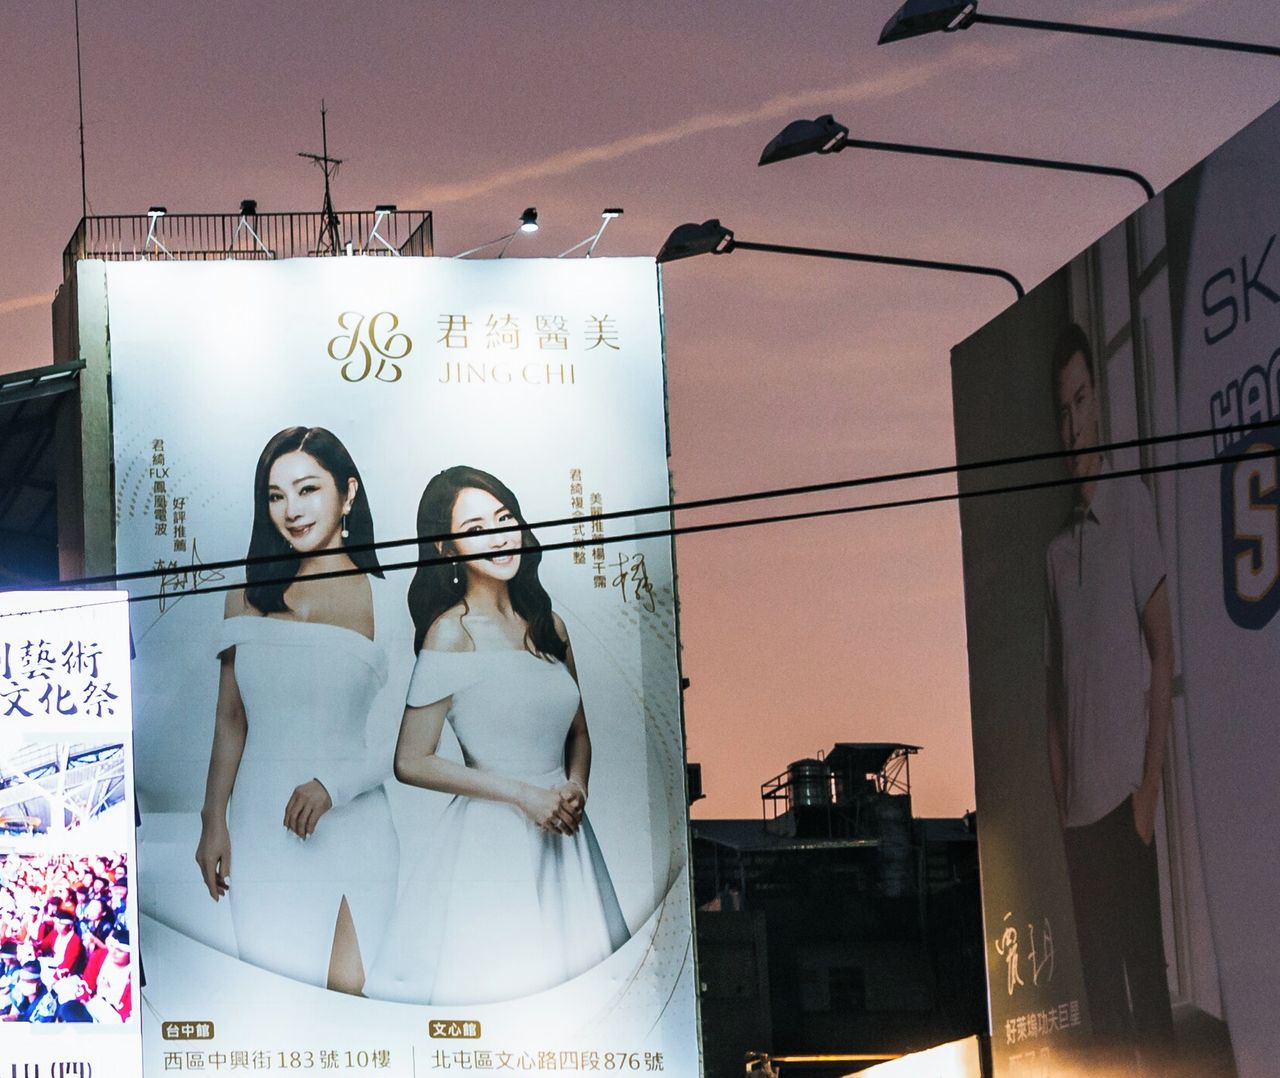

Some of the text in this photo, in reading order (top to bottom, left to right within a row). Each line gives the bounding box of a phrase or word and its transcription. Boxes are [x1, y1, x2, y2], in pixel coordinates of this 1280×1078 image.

[436, 313, 621, 351] 君綺醫美
[438, 362, 577, 385] JING CHI
[166, 1024, 210, 1038] 台中館
[432, 1022, 477, 1037] 文心館
[164, 1051, 391, 1071] 西區中興街183號10樓
[432, 1051, 664, 1071] 北屯區文心路四段876號
